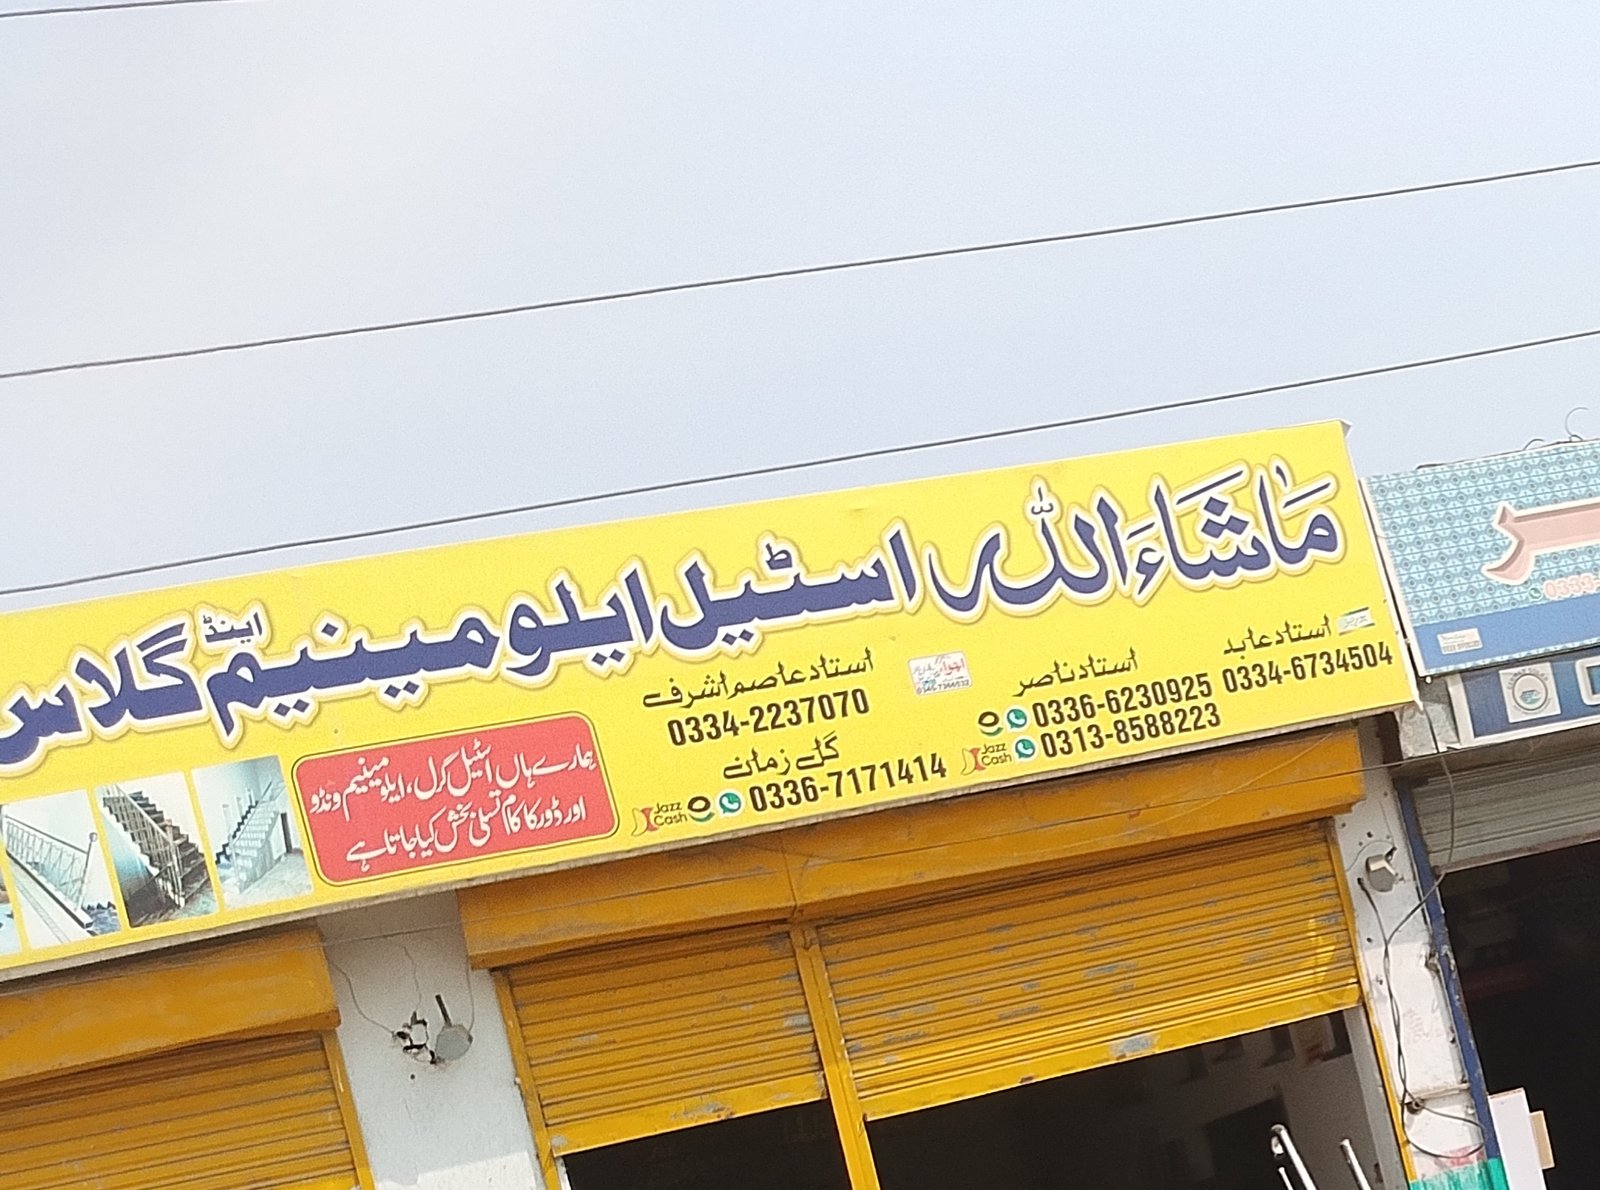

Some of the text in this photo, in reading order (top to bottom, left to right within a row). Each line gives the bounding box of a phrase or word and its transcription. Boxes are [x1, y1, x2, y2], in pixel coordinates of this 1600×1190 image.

[661, 529, 916, 650] اسٹیل
[203, 612, 262, 643] اینڈ
[727, 661, 806, 699] عاصم
[1012, 660, 1075, 697] ناصر
[1222, 641, 1393, 693] 0334-6734504
[0, 622, 202, 765] گلاس
[1032, 673, 1212, 727] 0336-6230925
[667, 688, 870, 746] 0334-2237070
[1041, 702, 1221, 758] 0313-8588223
[447, 737, 493, 797] اسٹیل
[532, 743, 596, 775] ہمارے
[981, 743, 1007, 755] Jazz
[981, 753, 1012, 766] Cash
[749, 752, 947, 813] 0336-7171414
[535, 796, 562, 829] ڈور
[563, 795, 586, 824] اور
[654, 802, 682, 815] Jazz
[654, 813, 688, 827] Cash
[346, 841, 388, 872] ہے
